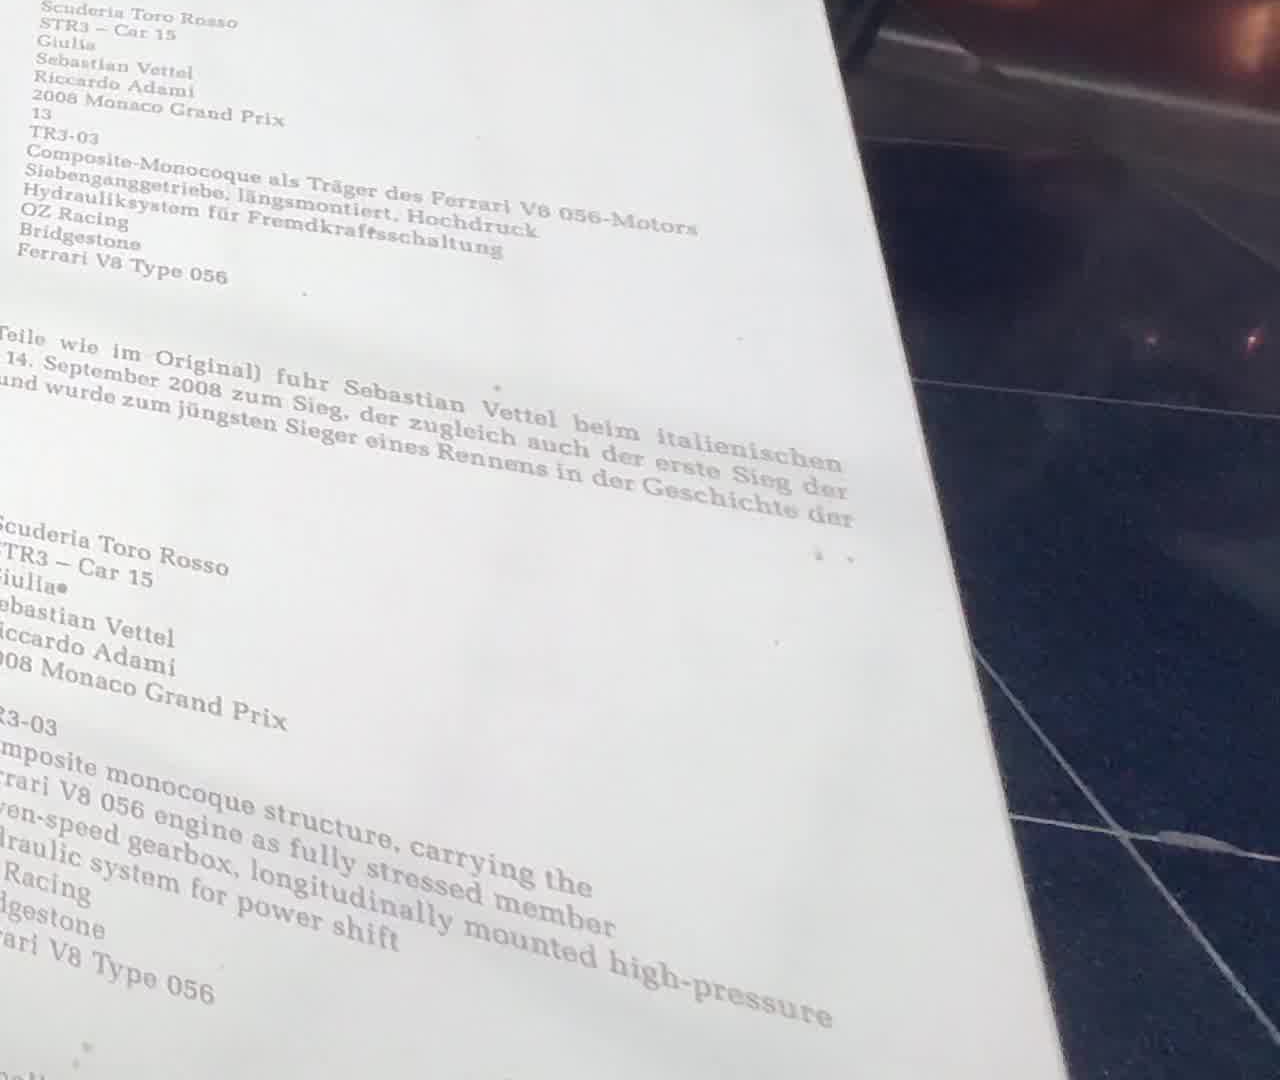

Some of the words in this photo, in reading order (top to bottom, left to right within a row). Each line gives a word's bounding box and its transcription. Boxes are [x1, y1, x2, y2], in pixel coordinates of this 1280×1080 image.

[39, 0, 125, 18] Scuderia
[130, 7, 175, 23] Toro
[179, 12, 239, 28] Rosso
[39, 16, 89, 33] STR3
[111, 23, 149, 38] Car
[154, 28, 177, 40] 15
[36, 34, 97, 51] Giulia
[35, 52, 129, 72] Sebastian
[135, 61, 193, 80] Vettel
[33, 69, 121, 90] Riccardo
[127, 79, 195, 98] Adami
[31, 88, 78, 104] 2008
[84, 92, 164, 113] Monaco
[169, 102, 233, 121] Grand
[240, 109, 286, 127] Prix
[31, 107, 53, 120] 13
[28, 124, 100, 145] TR3-03
[20, 201, 52, 218] OZ
[56, 206, 129, 232] Racing
[18, 222, 142, 250] Bridgestone
[17, 242, 89, 265] Ferrari
[95, 252, 123, 269] V8
[128, 257, 184, 279] Type
[186, 267, 229, 284] 056
[97, 534, 152, 560] Toro
[159, 546, 230, 576] Rosso
[77, 557, 120, 580] Car
[128, 569, 153, 588] 15
[105, 616, 175, 648] Vettel
[92, 644, 176, 676] Adami
[40, 658, 137, 696] Monaco
[144, 681, 223, 716] Grand
[231, 700, 288, 731] Prix
[105, 766, 257, 815] monocoque
[409, 841, 537, 887] carrying
[544, 867, 593, 897] the
[59, 778, 92, 806] V8
[100, 792, 145, 819] 056
[154, 809, 244, 843] engine
[251, 833, 281, 853] as
[288, 836, 357, 875] fully
[366, 862, 485, 904] stressed
[493, 893, 617, 937] member
[3, 863, 92, 908] Racing
[89, 857, 181, 893] system
[191, 876, 228, 905] for
[237, 895, 325, 930] power
[332, 914, 399, 951] shift
[250, 858, 457, 932] longitudinally
[463, 920, 598, 967] mounted
[609, 950, 833, 1027] high-pressure
[48, 937, 82, 968] V8
[91, 950, 158, 988] Type
[166, 974, 215, 1004] 056
